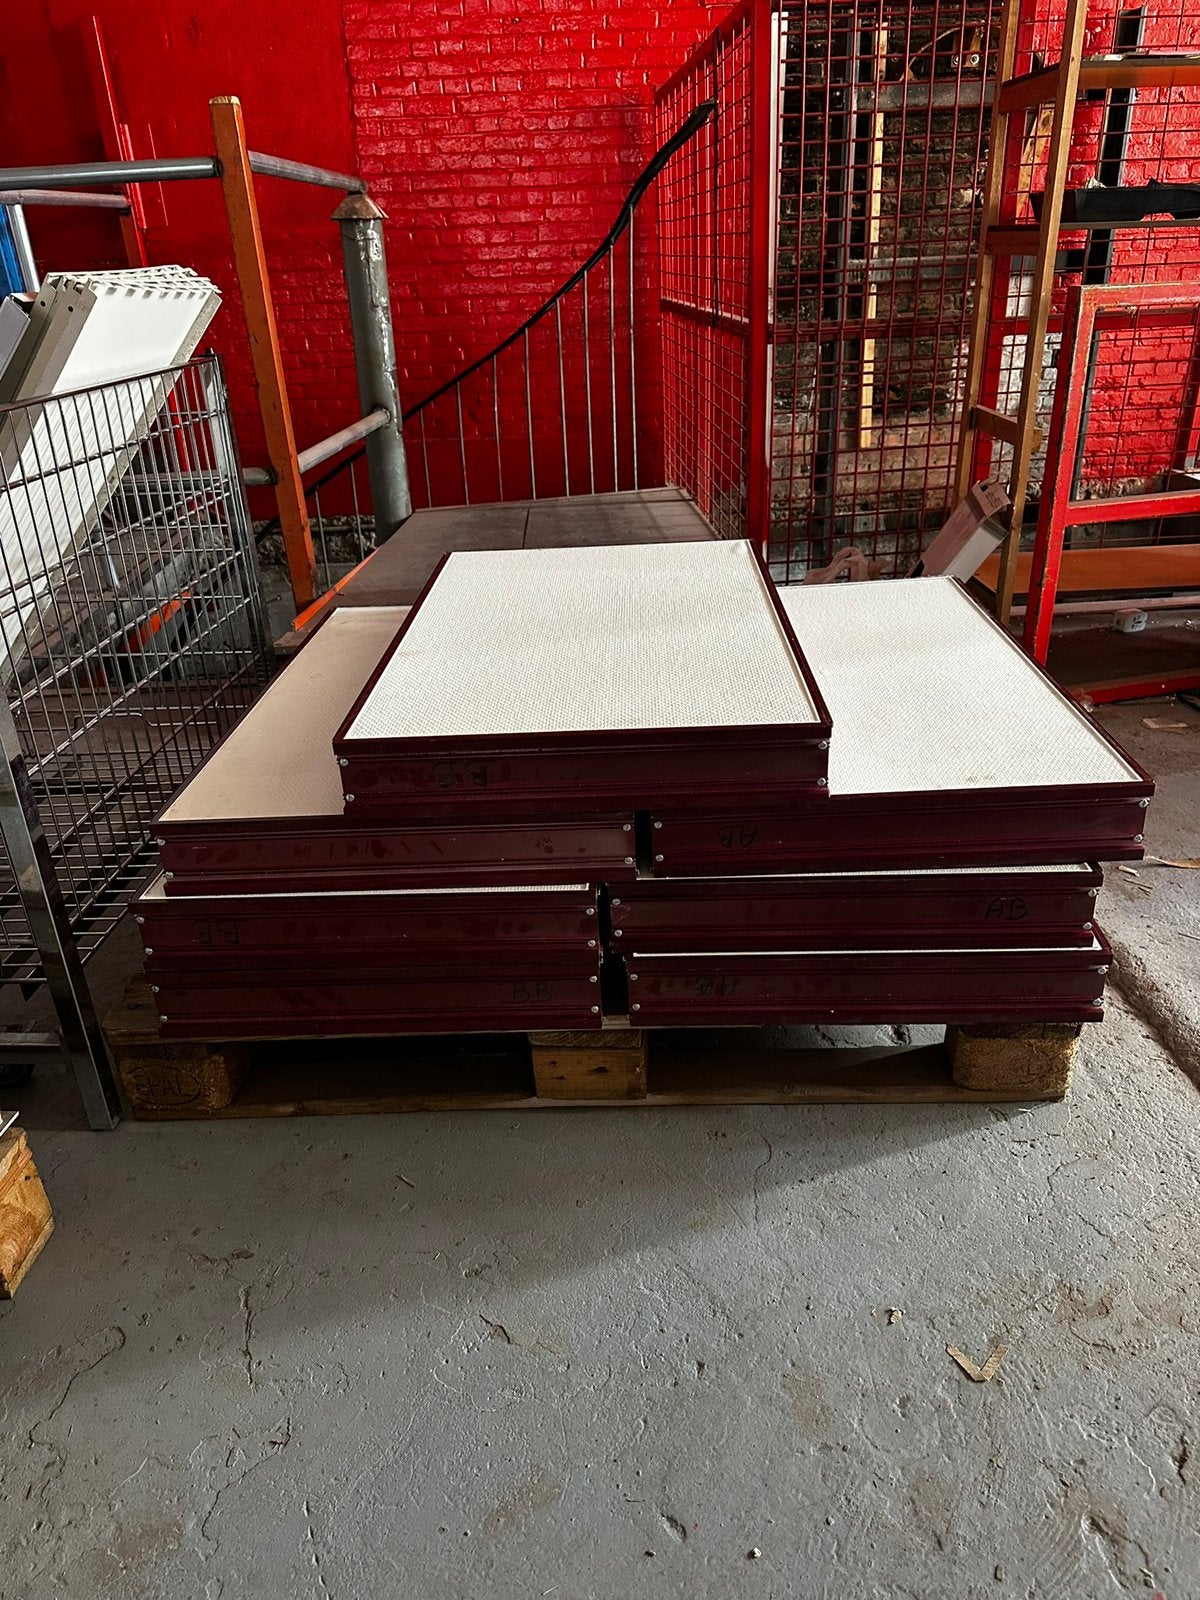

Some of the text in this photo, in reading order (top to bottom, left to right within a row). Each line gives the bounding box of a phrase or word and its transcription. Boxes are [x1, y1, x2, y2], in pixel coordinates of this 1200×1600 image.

[716, 824, 758, 848] AB
[984, 897, 1029, 921] AB
[502, 980, 553, 1005] BB
[133, 1073, 194, 1098] EPAL
